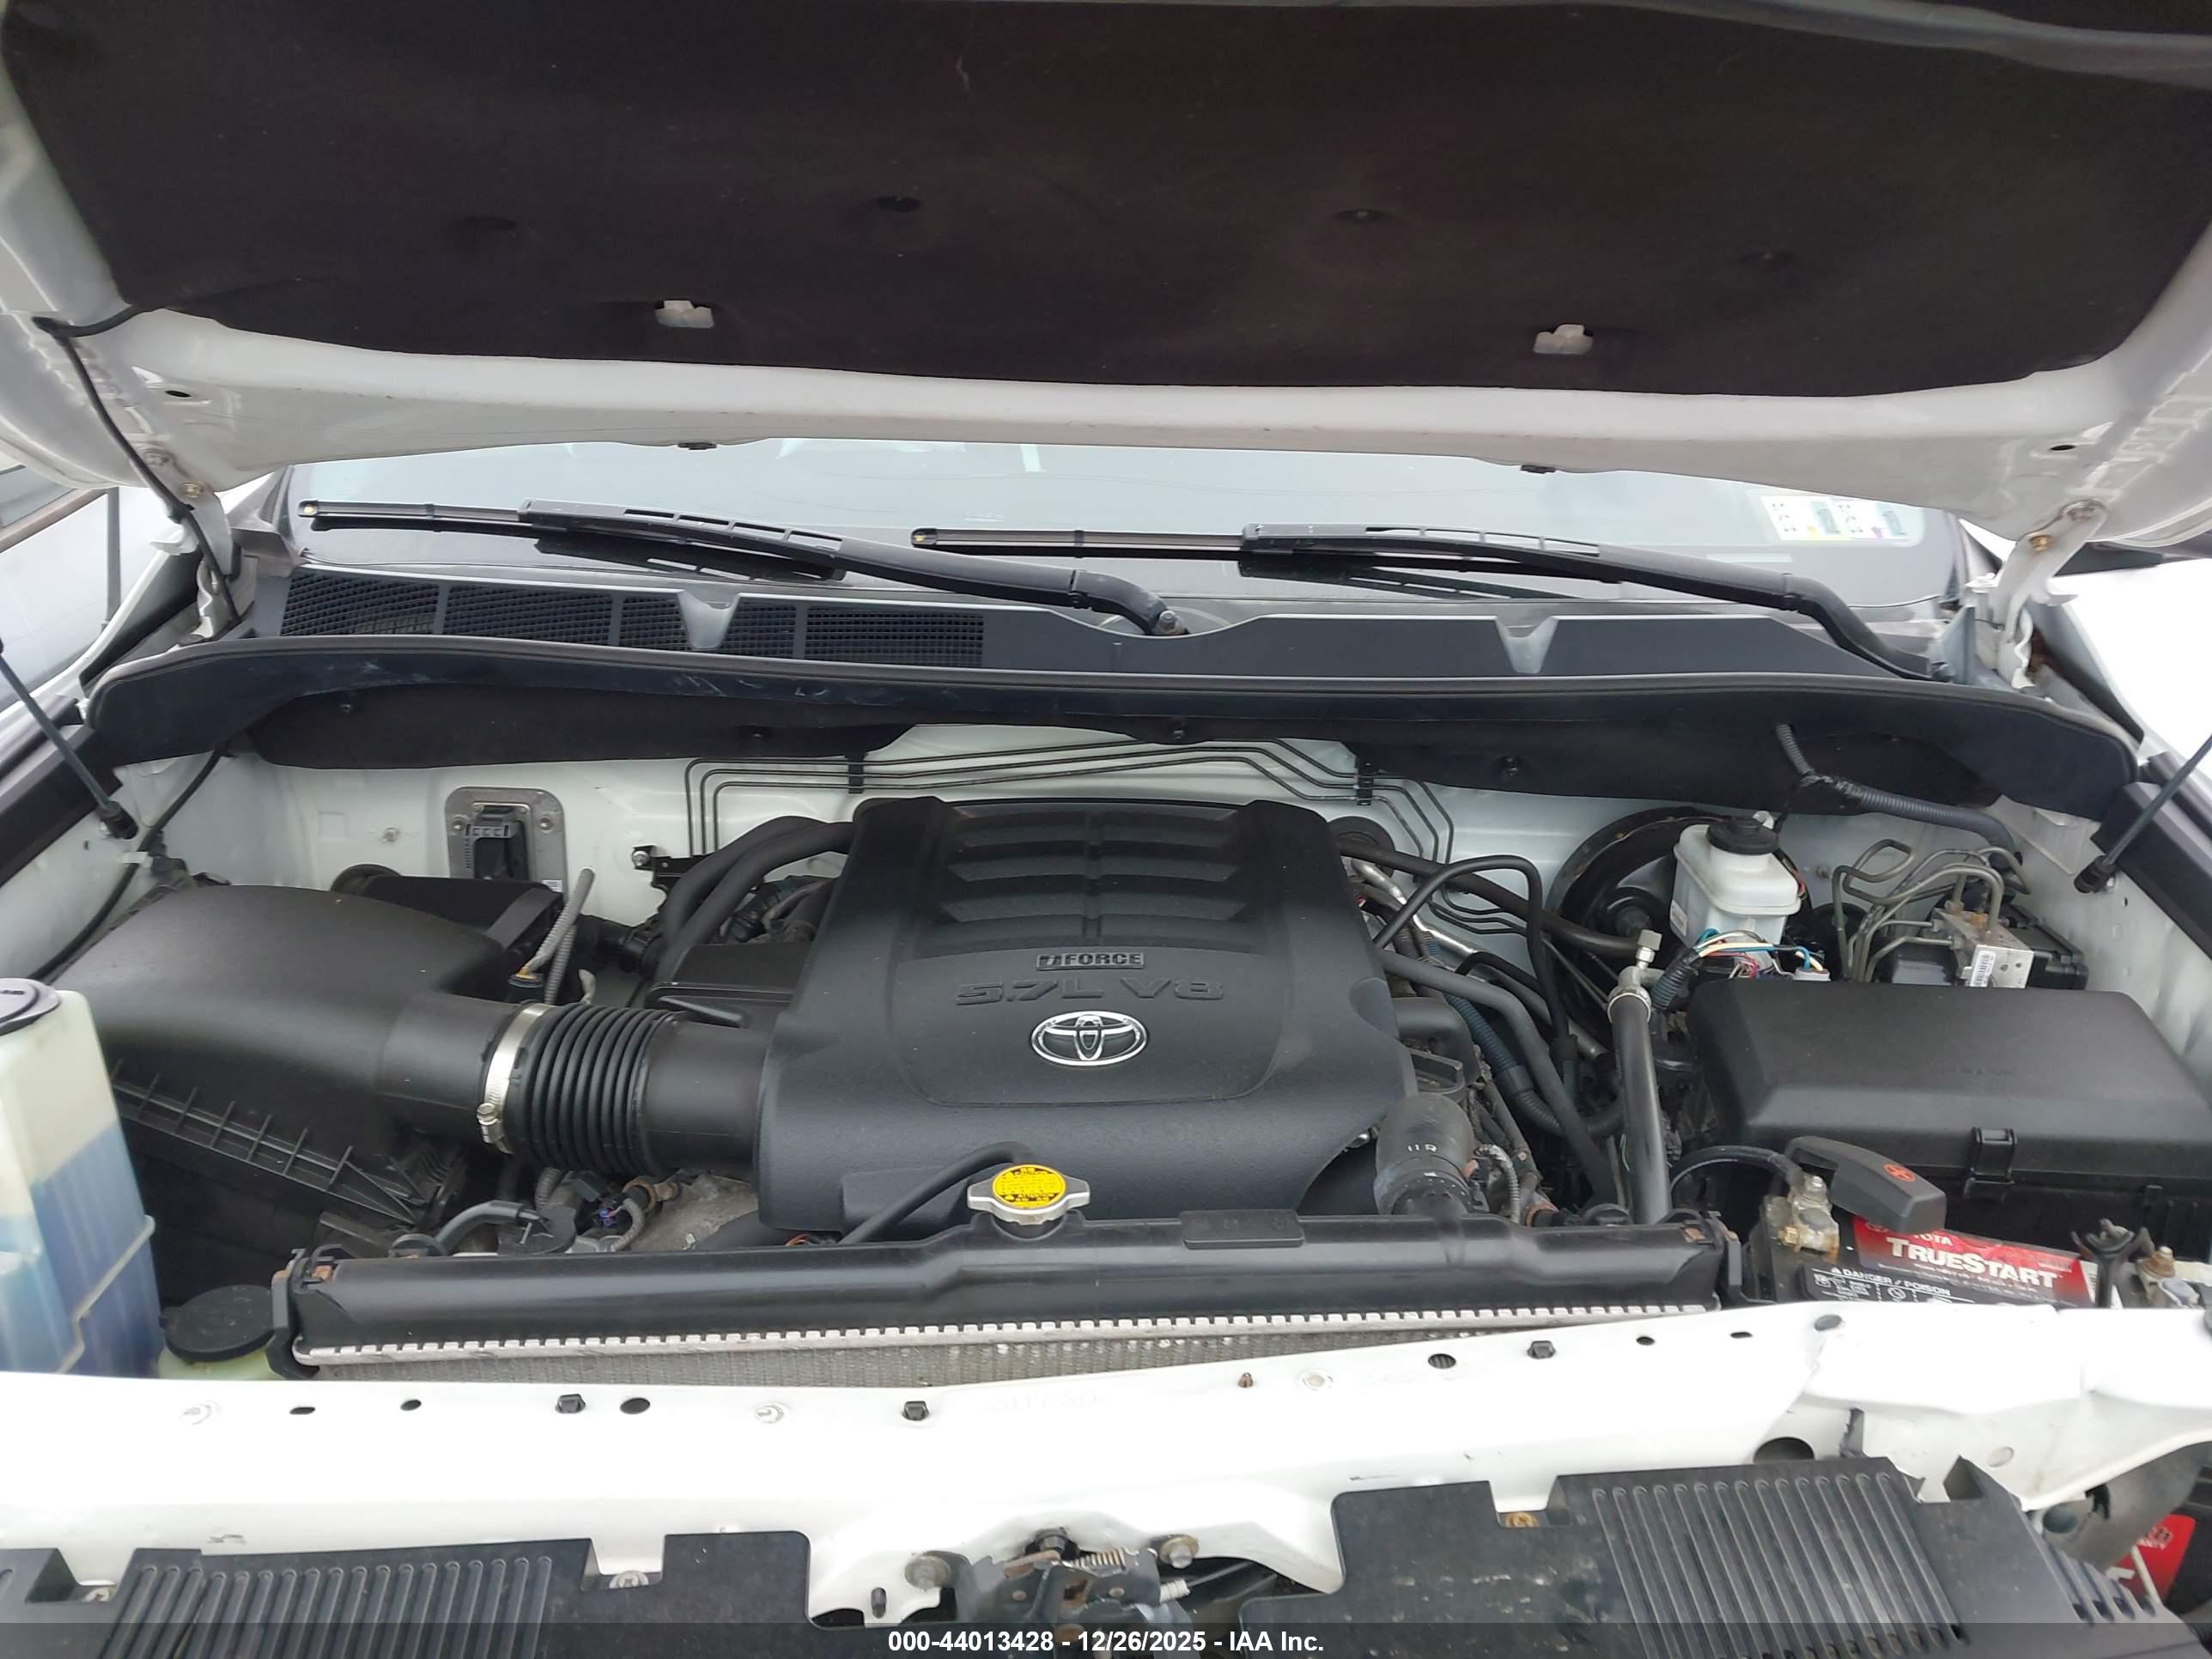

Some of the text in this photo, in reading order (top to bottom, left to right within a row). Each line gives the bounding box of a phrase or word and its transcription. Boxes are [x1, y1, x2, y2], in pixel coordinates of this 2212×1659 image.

[955, 977, 1224, 1006] 5.7L V8
[1886, 1237, 2058, 1288] TRUESTART
[1844, 1268, 1893, 1285] DANGER
[1904, 1280, 1952, 1297] POISON
